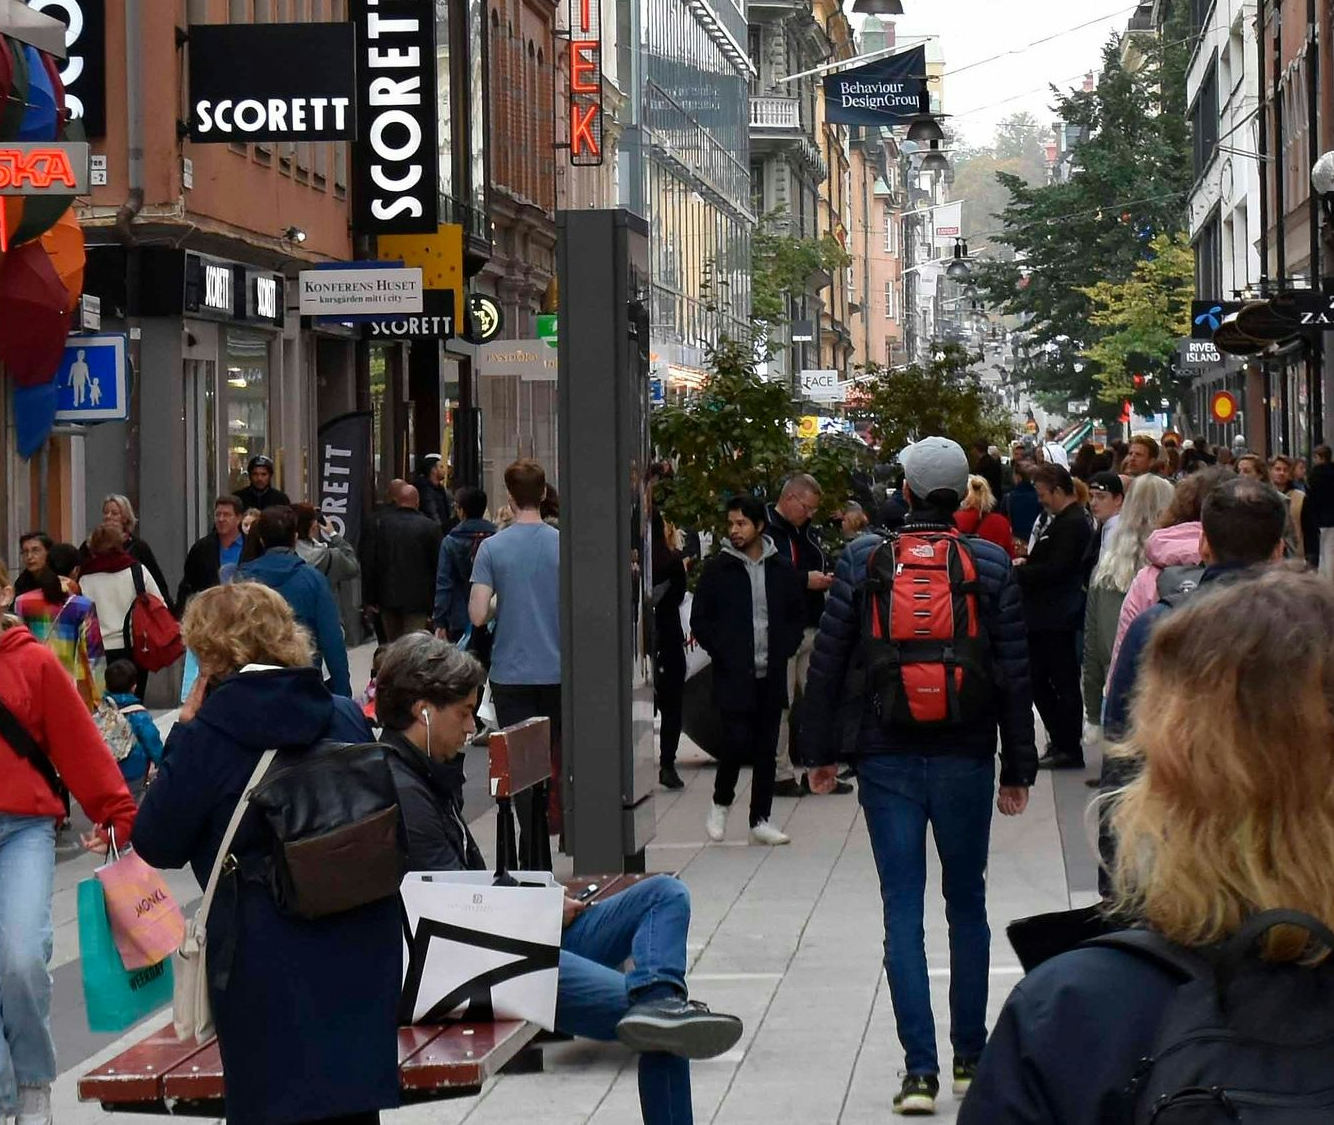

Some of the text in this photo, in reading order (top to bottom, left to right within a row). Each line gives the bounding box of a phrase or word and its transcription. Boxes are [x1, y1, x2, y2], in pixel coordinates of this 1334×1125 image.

[840, 81, 904, 94] Behaviour
[197, 97, 349, 133] SCORETT
[305, 280, 417, 293] KONFERENS HUSET
[319, 294, 364, 304] kursgården
[365, 294, 382, 303] mitt
[388, 293, 403, 304] city
[372, 317, 452, 336] SCORETT
[1189, 342, 1217, 352] RIVER
[1186, 352, 1221, 363] ISLAND
[806, 376, 833, 387] FACE
[320, 444, 352, 542] ORETT
